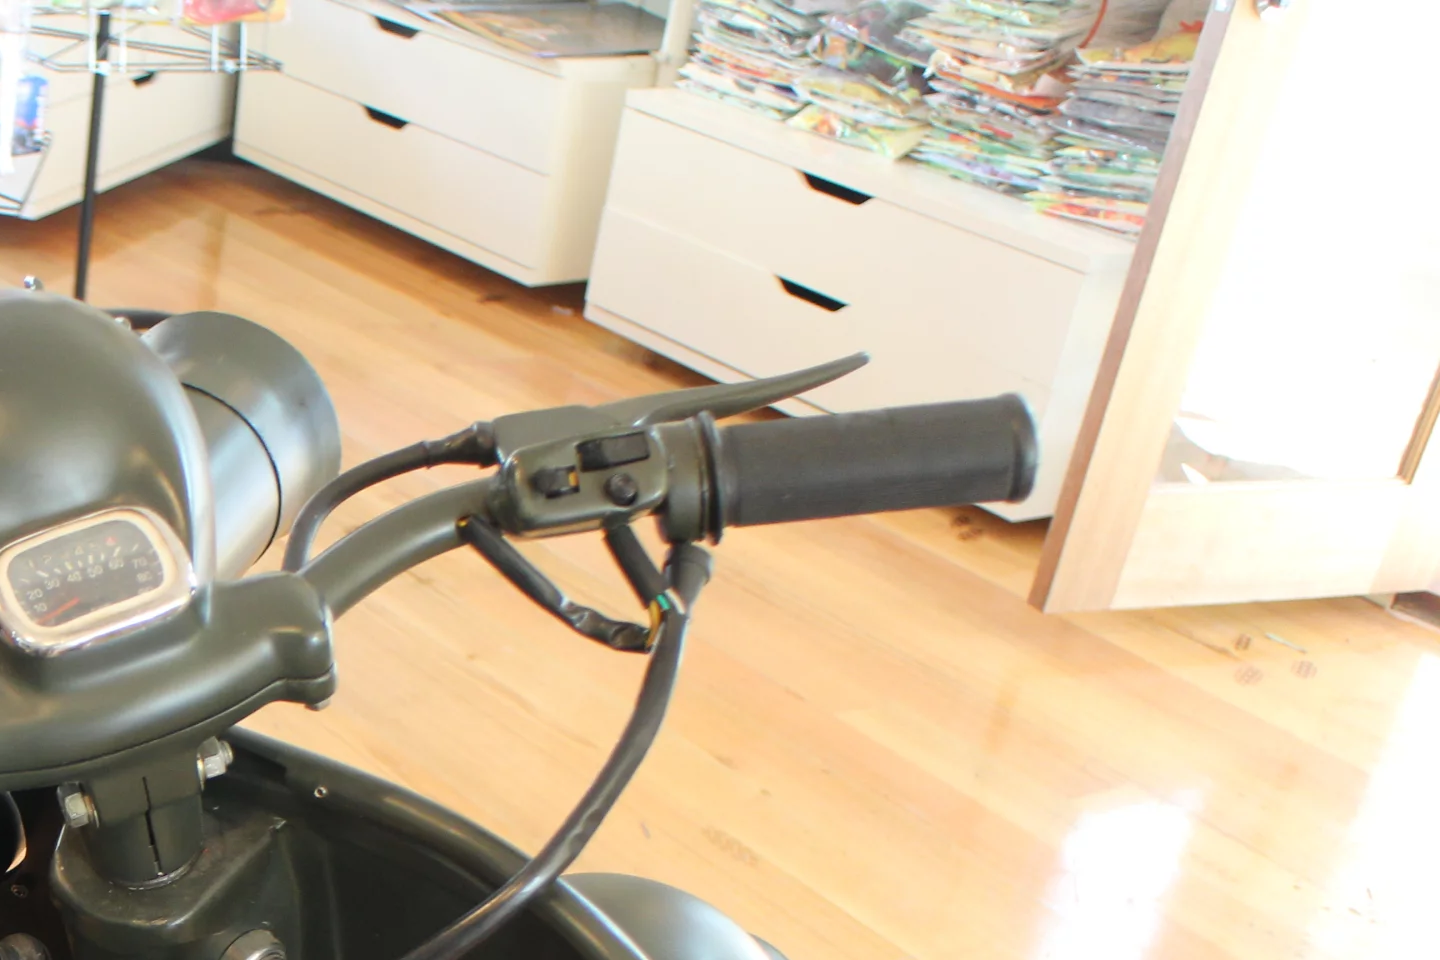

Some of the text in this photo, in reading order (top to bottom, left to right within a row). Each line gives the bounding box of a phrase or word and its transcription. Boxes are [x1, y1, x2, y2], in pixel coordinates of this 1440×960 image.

[87, 565, 103, 578] 50
[44, 578, 60, 590] 30
[26, 588, 43, 601] 20
[33, 602, 48, 613] 10
